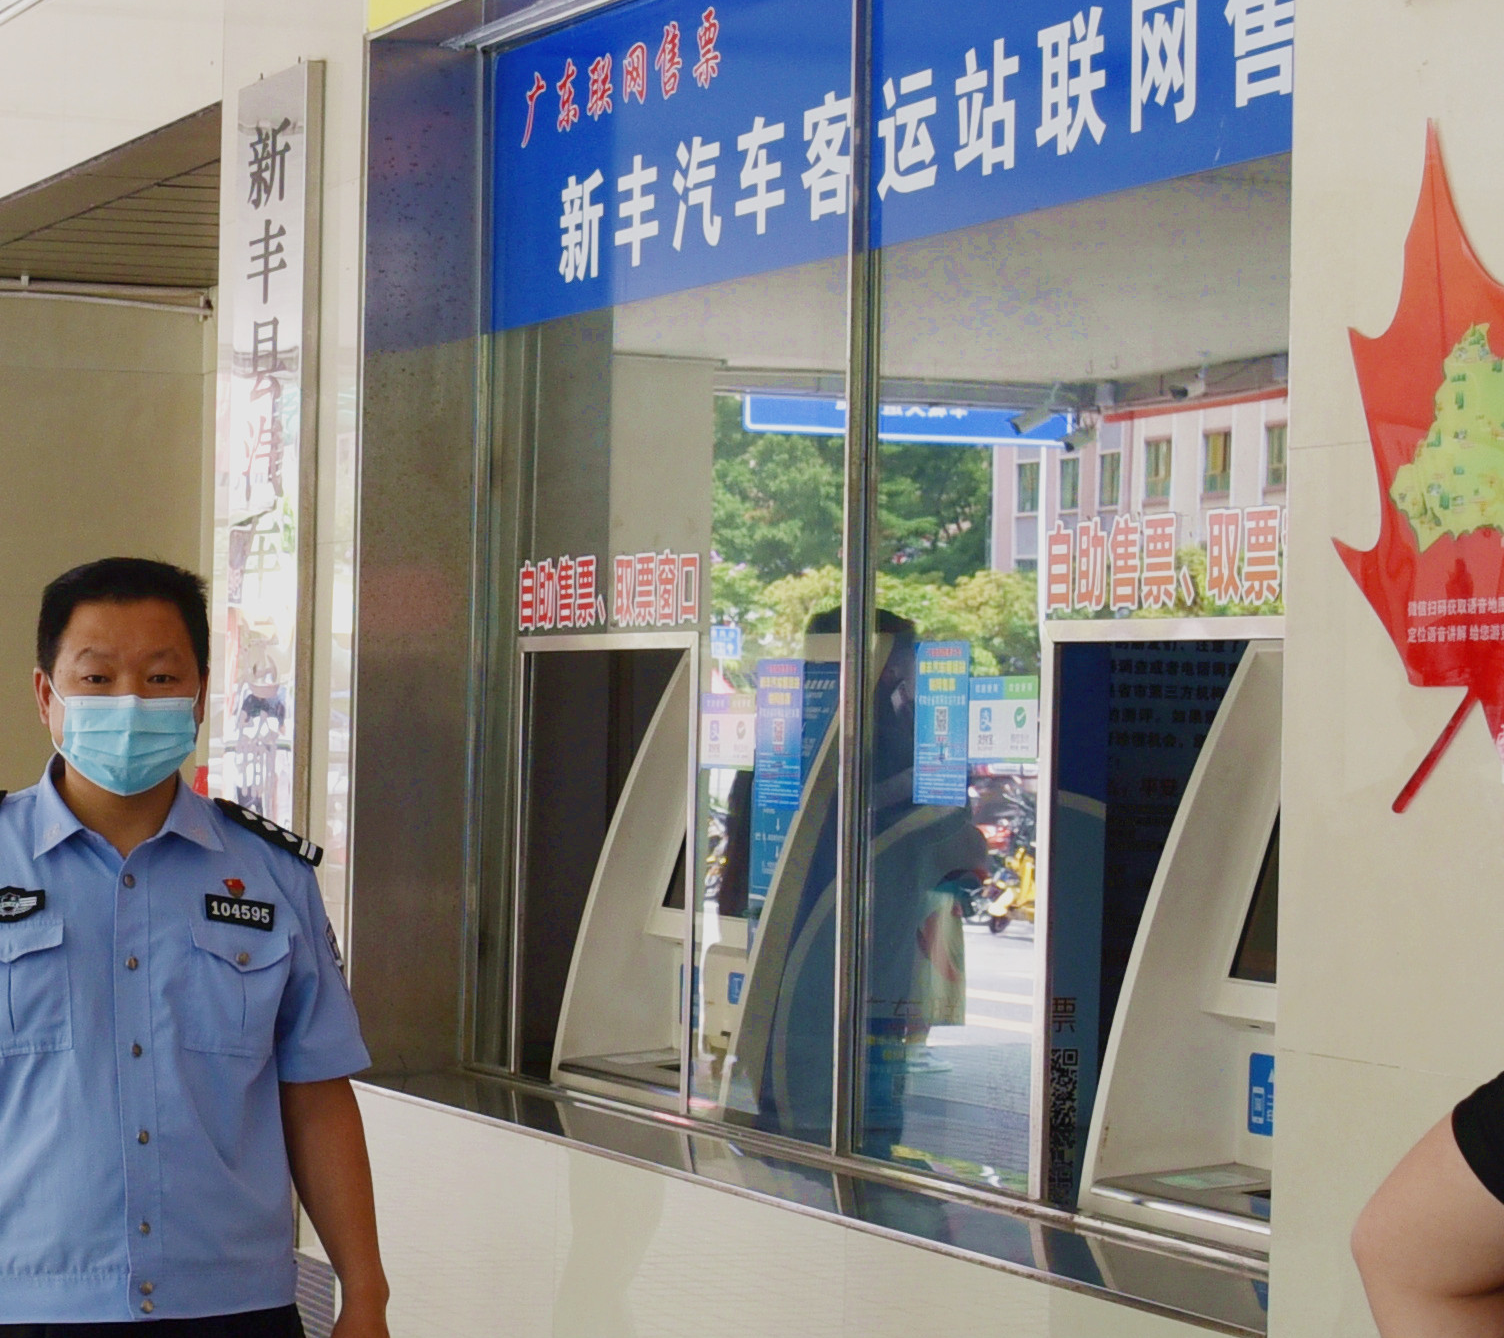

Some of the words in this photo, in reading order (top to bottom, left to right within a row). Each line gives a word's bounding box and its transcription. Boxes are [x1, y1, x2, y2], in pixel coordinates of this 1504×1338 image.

[520, 6, 722, 149] 广东联网售票
[518, 550, 701, 631] 自助售票、取票窗口
[1046, 507, 1288, 614] 自助售票、取票
[211, 901, 271, 924] 104595
